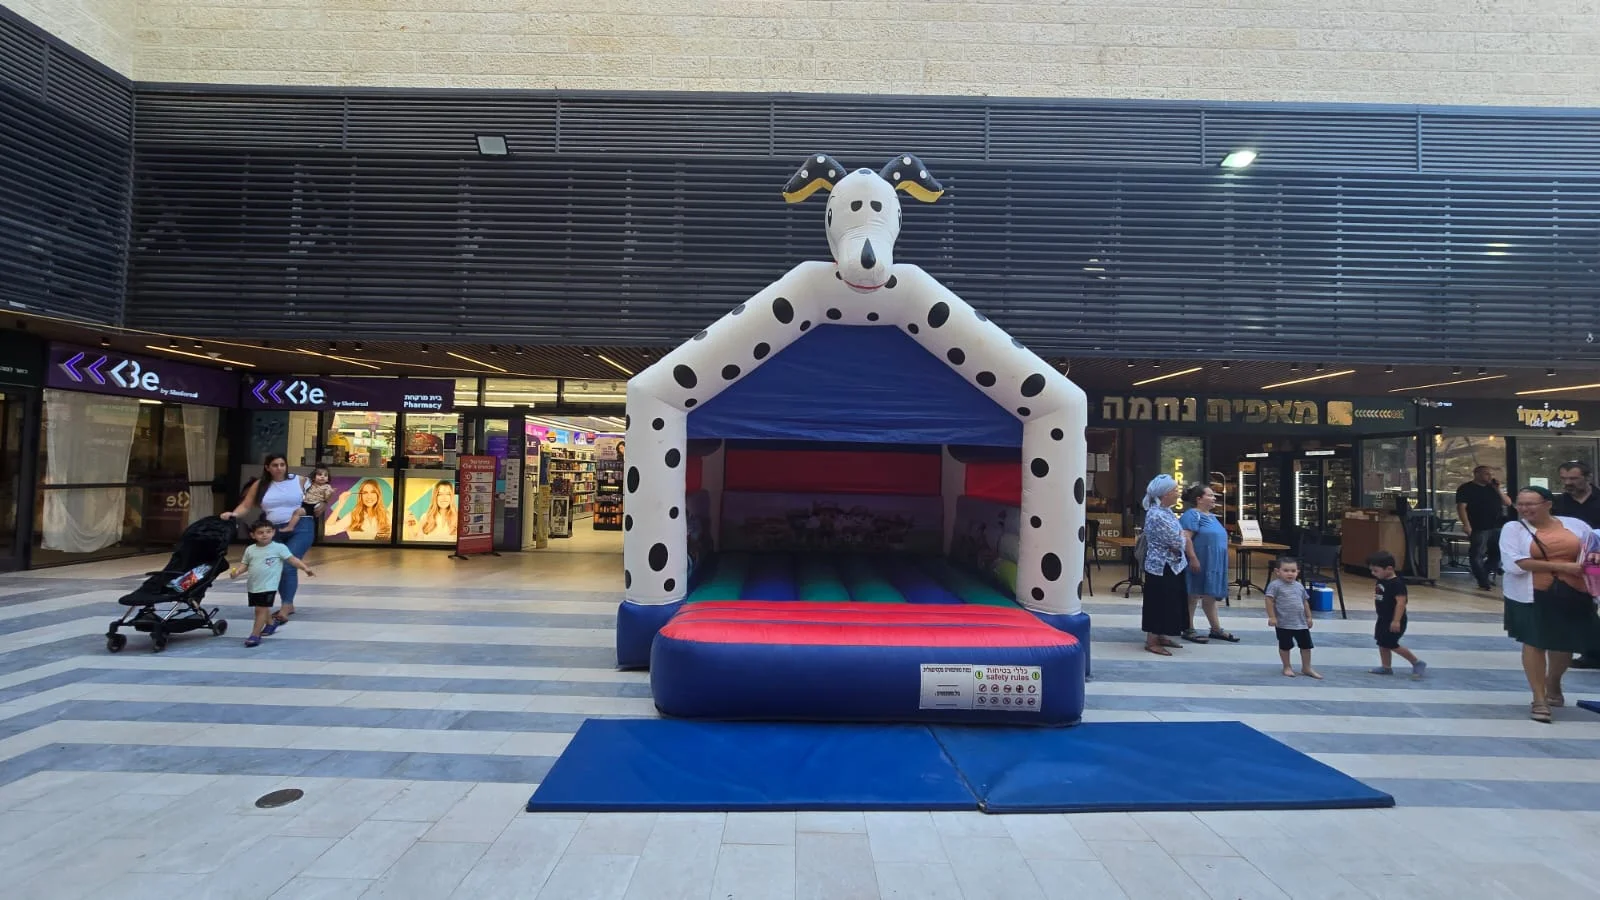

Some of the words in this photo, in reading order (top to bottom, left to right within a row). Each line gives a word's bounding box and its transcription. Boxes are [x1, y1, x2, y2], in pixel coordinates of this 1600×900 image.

[160, 388, 169, 396] by
[404, 394, 429, 402] מרקחת
[403, 400, 442, 410] Pharmacy
[1102, 396, 1198, 422] נחמה
[1174, 458, 1184, 519] FRES
[1096, 529, 1120, 538] AKED
[1013, 666, 1029, 674] כללי
[986, 673, 1009, 682] safety
